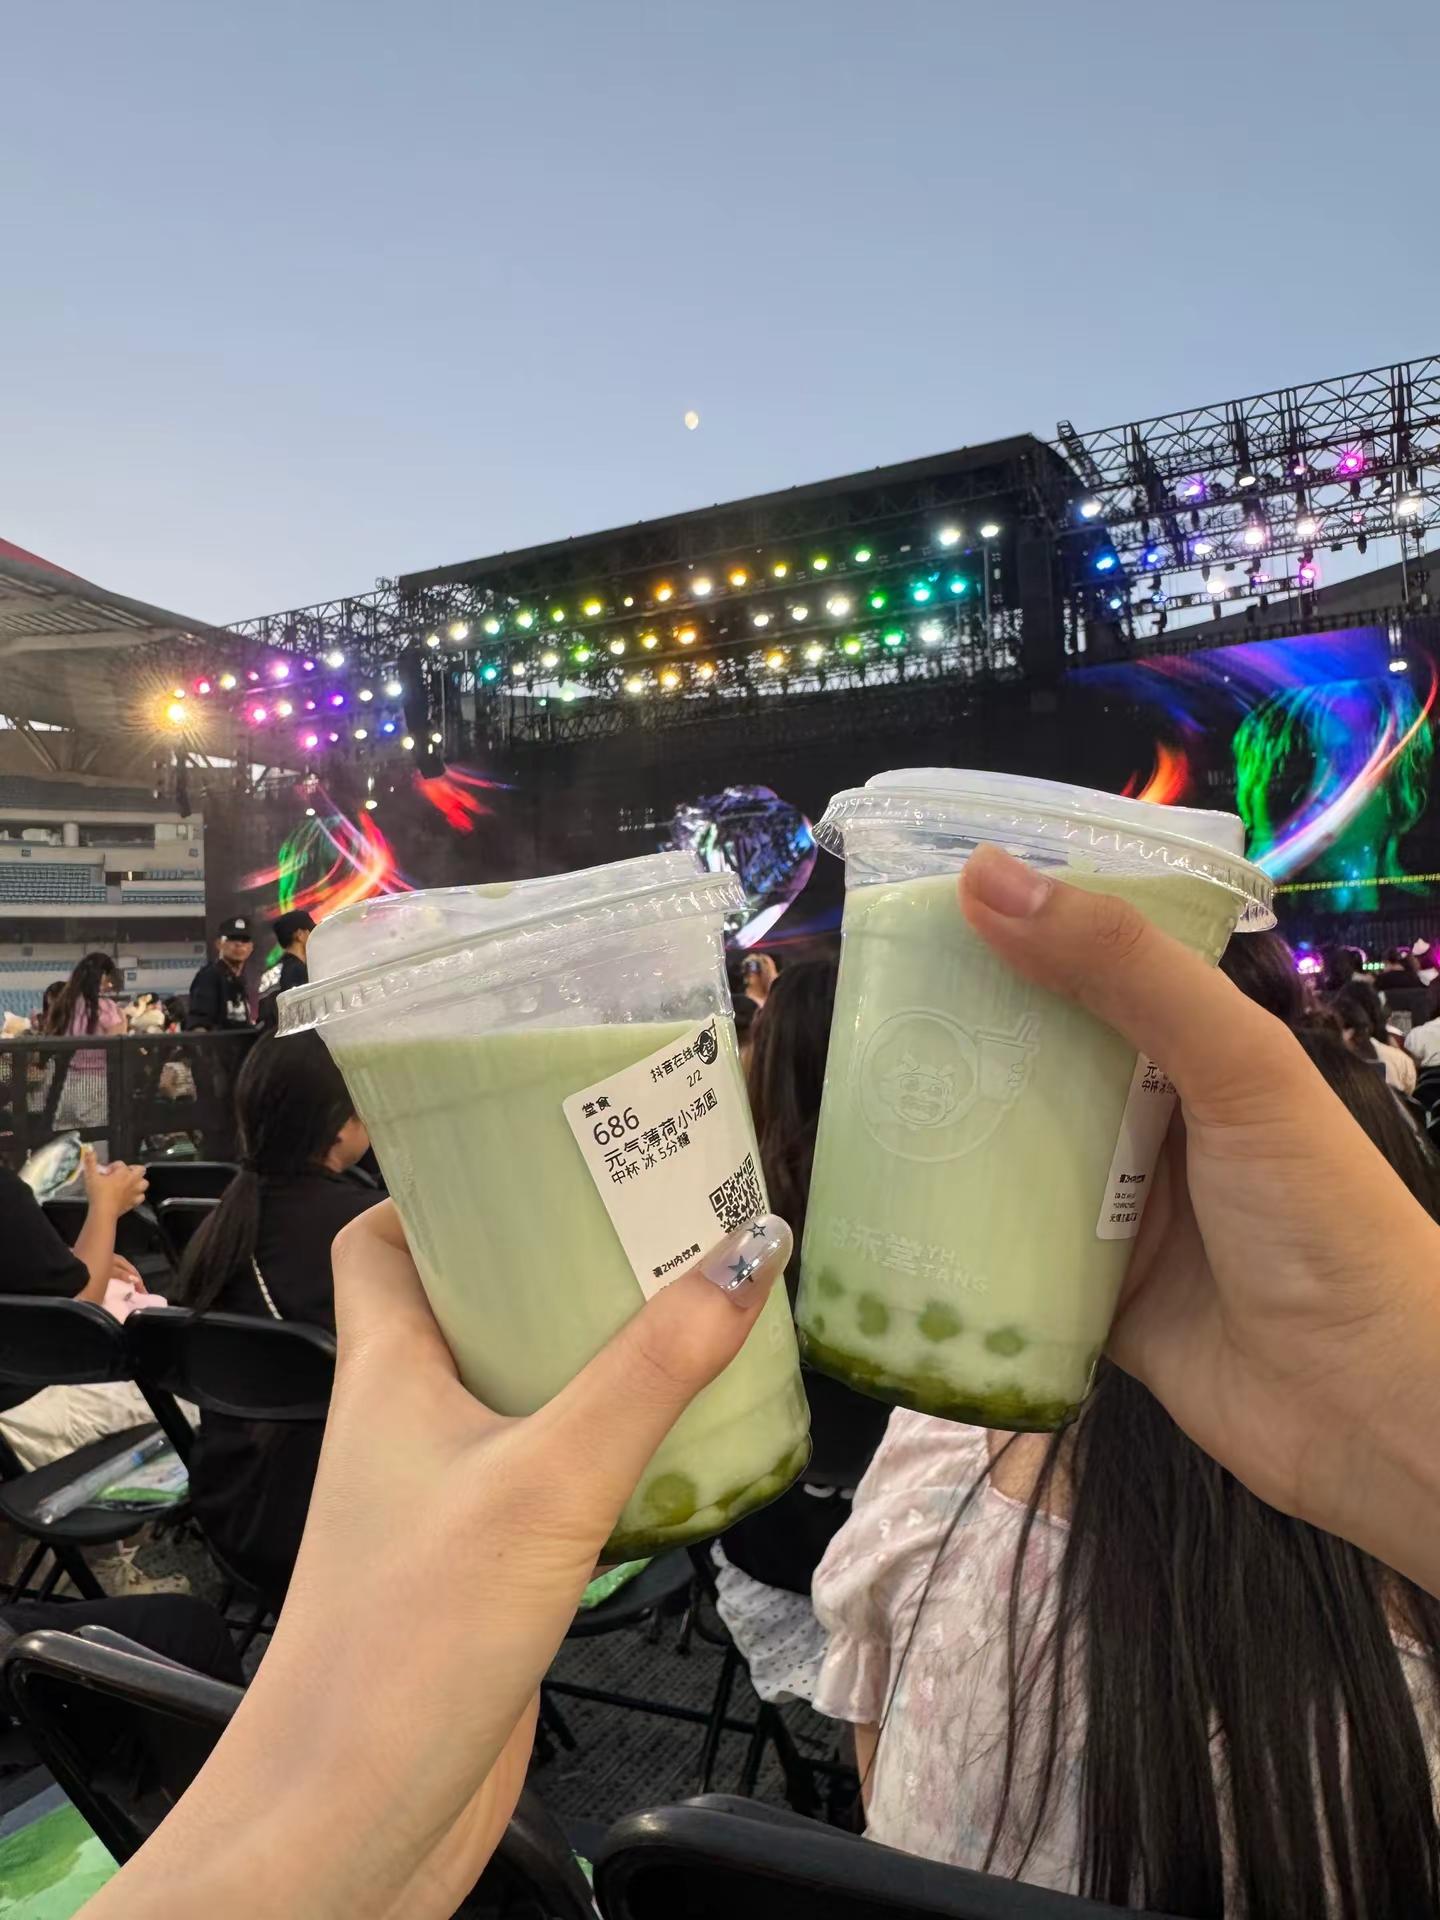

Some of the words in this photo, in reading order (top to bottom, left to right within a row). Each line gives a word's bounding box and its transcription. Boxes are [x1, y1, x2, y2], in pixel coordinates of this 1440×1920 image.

[686, 1069, 703, 1087] 2/2
[582, 1096, 612, 1118] 堂食
[593, 1107, 640, 1145] 686
[604, 1088, 718, 1172] 元气薄荷小汤圆
[611, 1161, 641, 1185] 中杯
[644, 1154, 657, 1170] 冰
[658, 1131, 691, 1160] 5分糖
